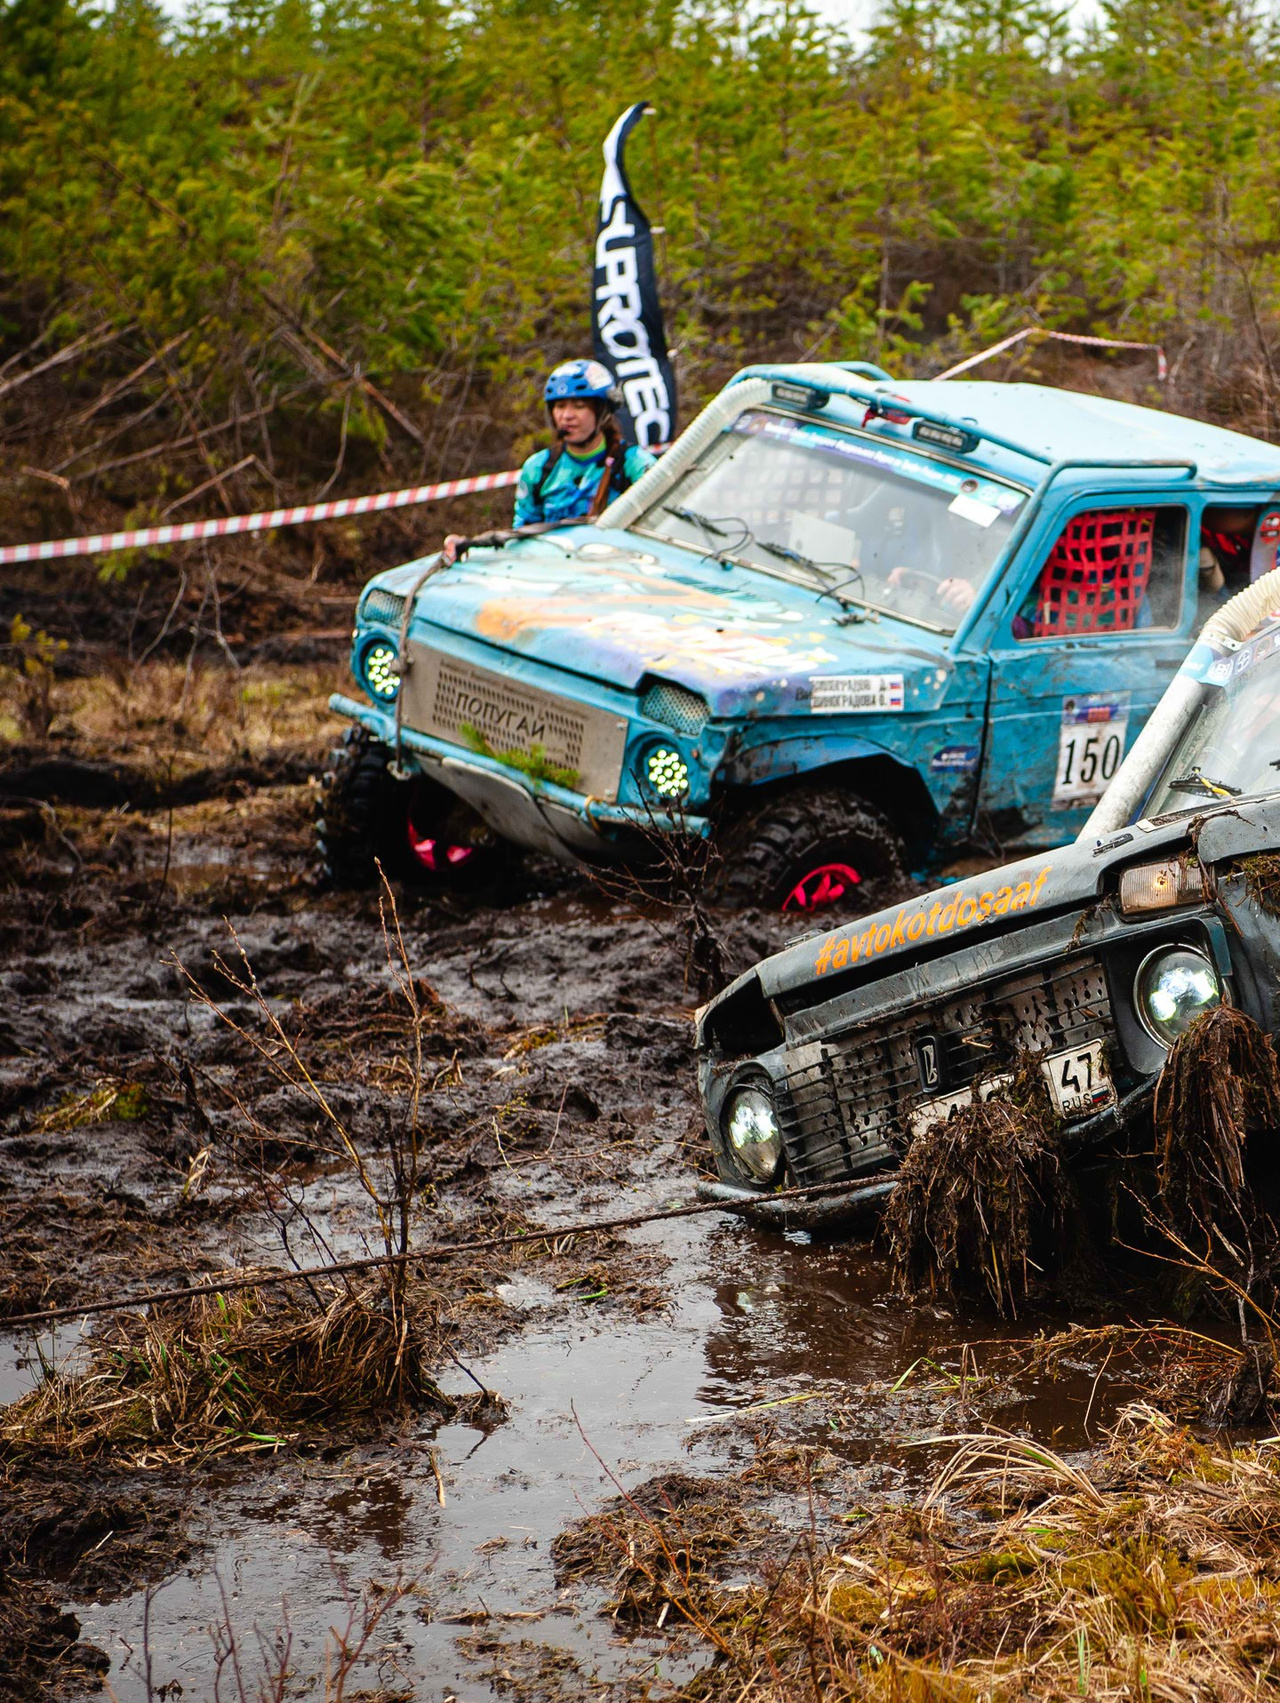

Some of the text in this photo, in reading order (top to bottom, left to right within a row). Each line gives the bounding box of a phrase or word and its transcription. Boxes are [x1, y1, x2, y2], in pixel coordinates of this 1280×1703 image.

[596, 192, 671, 448] SUPROTEC
[455, 691, 547, 741] ПОПУГАЙ
[1062, 735, 1120, 786] 150
[814, 866, 1052, 976] #avtokotdosaaf
[1061, 1052, 1093, 1094] 47
[1062, 1092, 1093, 1113] RUS
